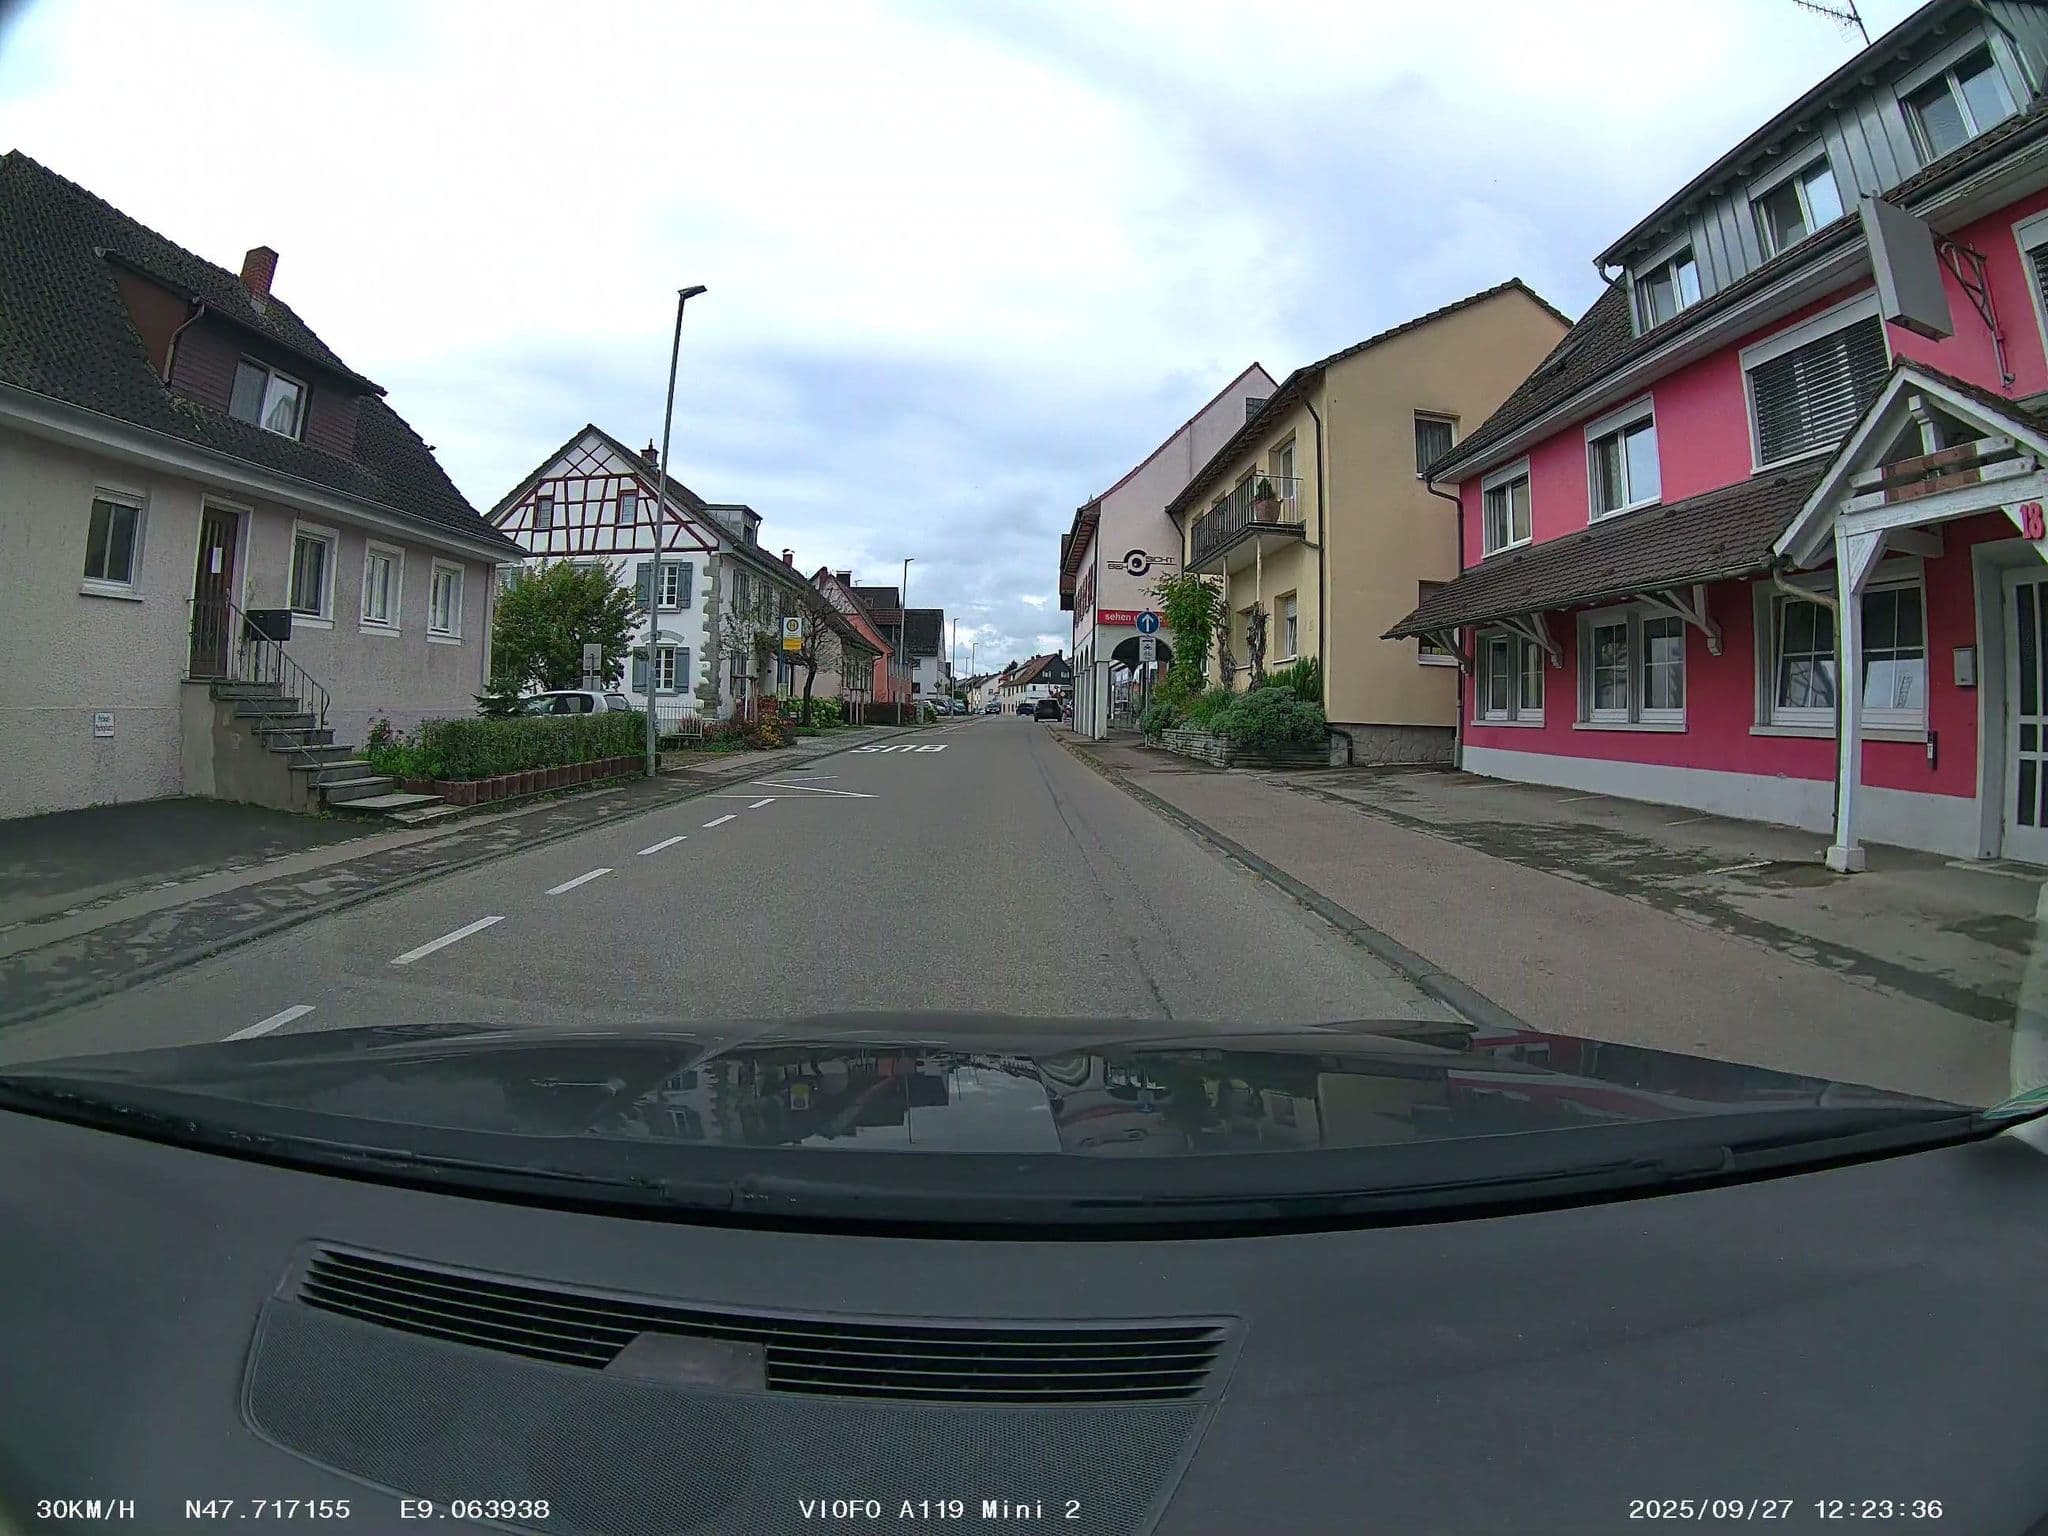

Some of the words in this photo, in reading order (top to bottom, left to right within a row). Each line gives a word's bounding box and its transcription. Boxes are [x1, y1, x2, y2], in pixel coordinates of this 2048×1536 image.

[2020, 502, 2046, 540] 18
[1104, 612, 1132, 622] sehen
[848, 744, 949, 753] BUS
